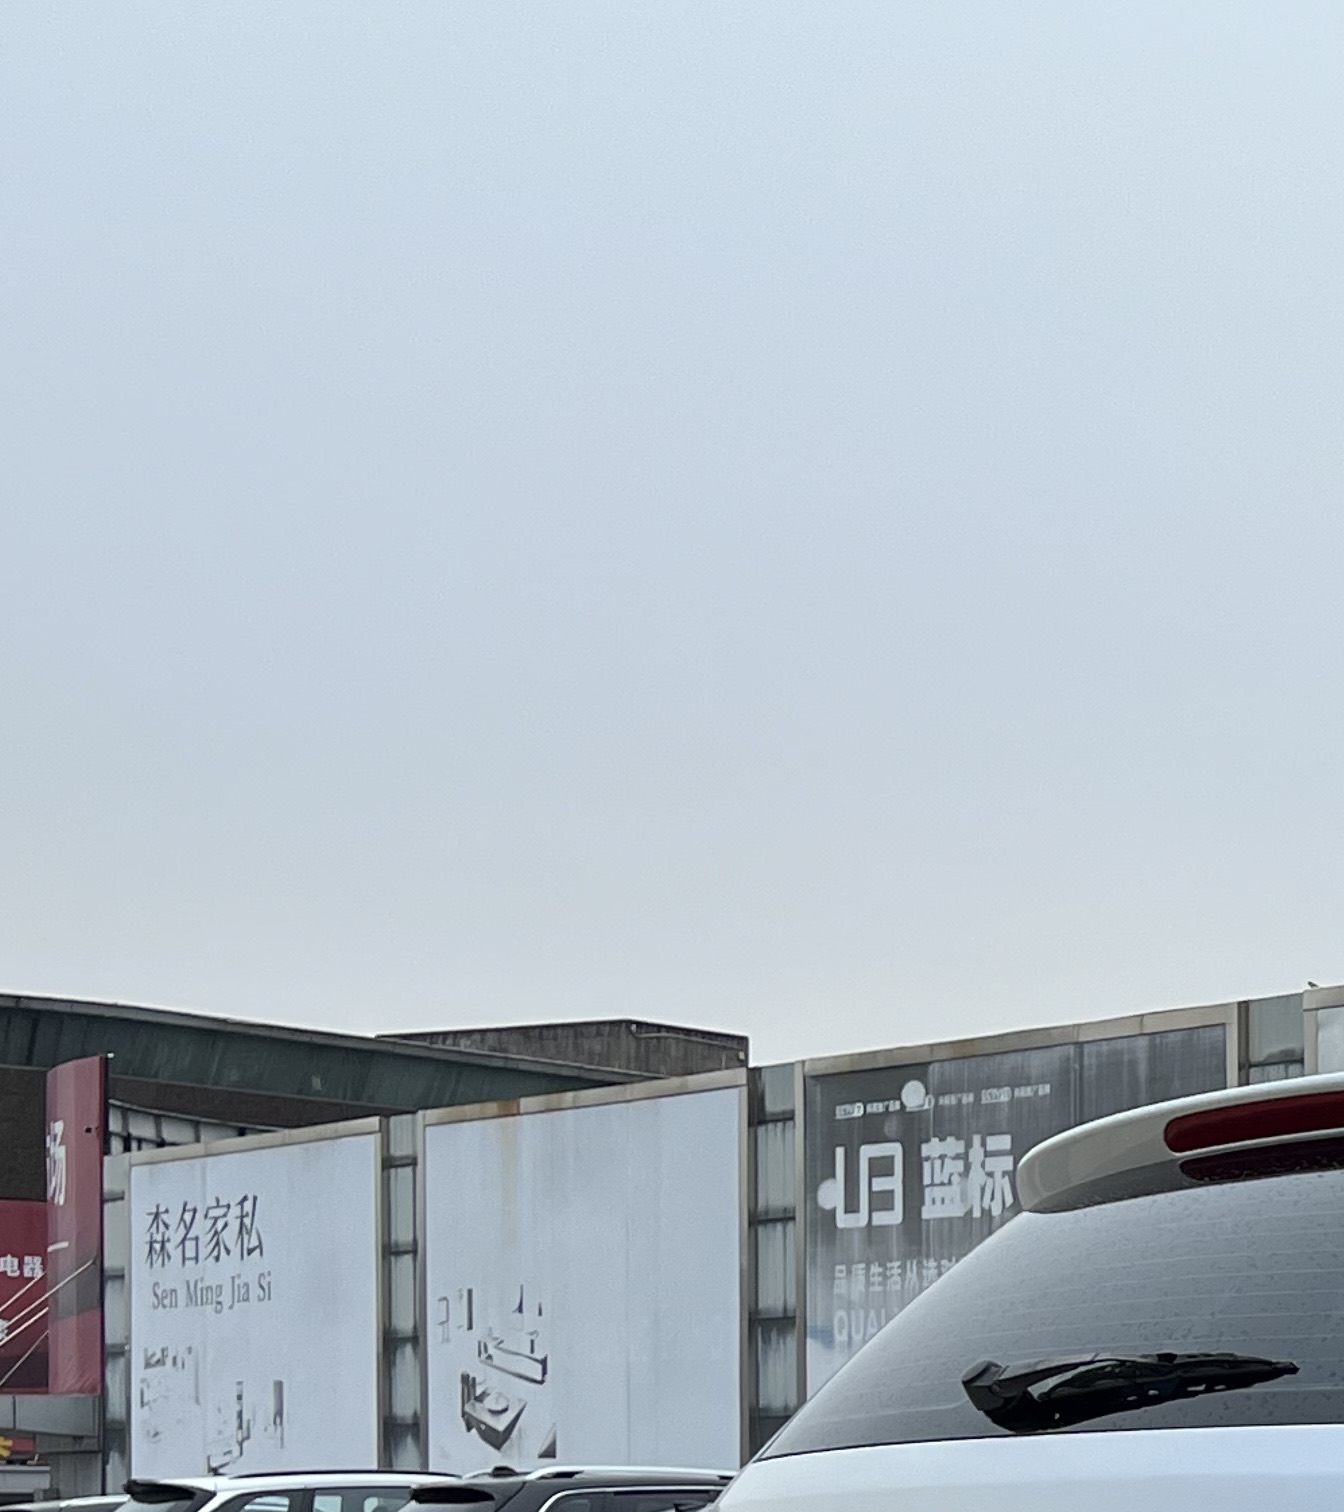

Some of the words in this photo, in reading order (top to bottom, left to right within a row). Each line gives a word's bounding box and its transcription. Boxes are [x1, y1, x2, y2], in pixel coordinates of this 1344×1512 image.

[921, 1134, 1014, 1220] 蓝标
[145, 1194, 264, 1269] 森名家私
[152, 1280, 178, 1310] Sen
[185, 1276, 224, 1314] Ming
[228, 1273, 251, 1310] Jia
[257, 1271, 272, 1302] Si
